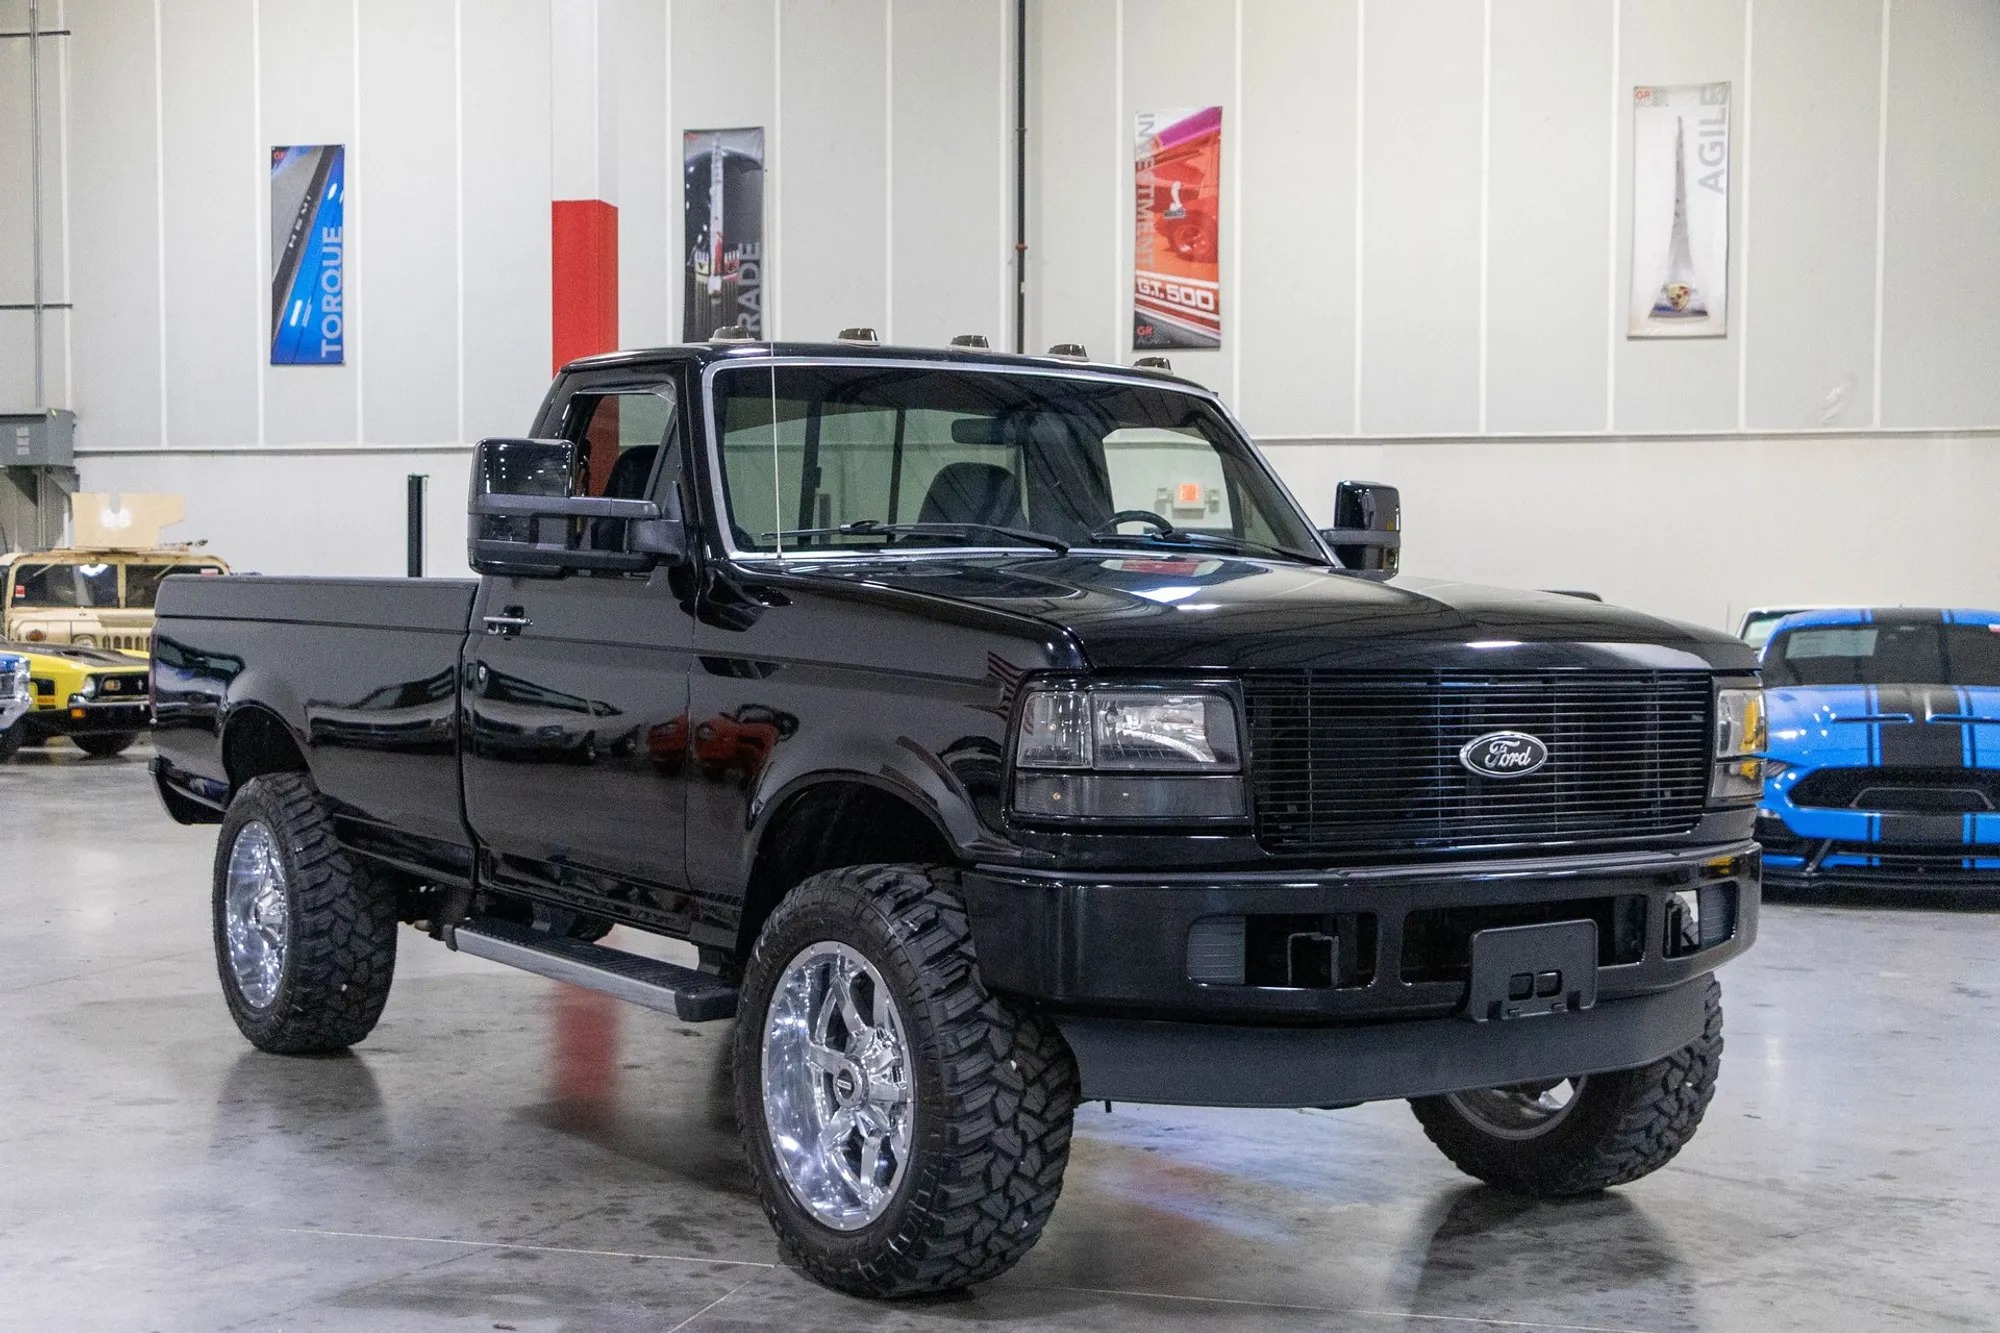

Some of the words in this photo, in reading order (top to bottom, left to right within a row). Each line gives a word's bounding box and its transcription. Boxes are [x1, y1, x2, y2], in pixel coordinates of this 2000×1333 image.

[1698, 86, 1727, 194] AGILE
[321, 226, 343, 358] TORQUE
[1484, 740, 1532, 768] Ford
